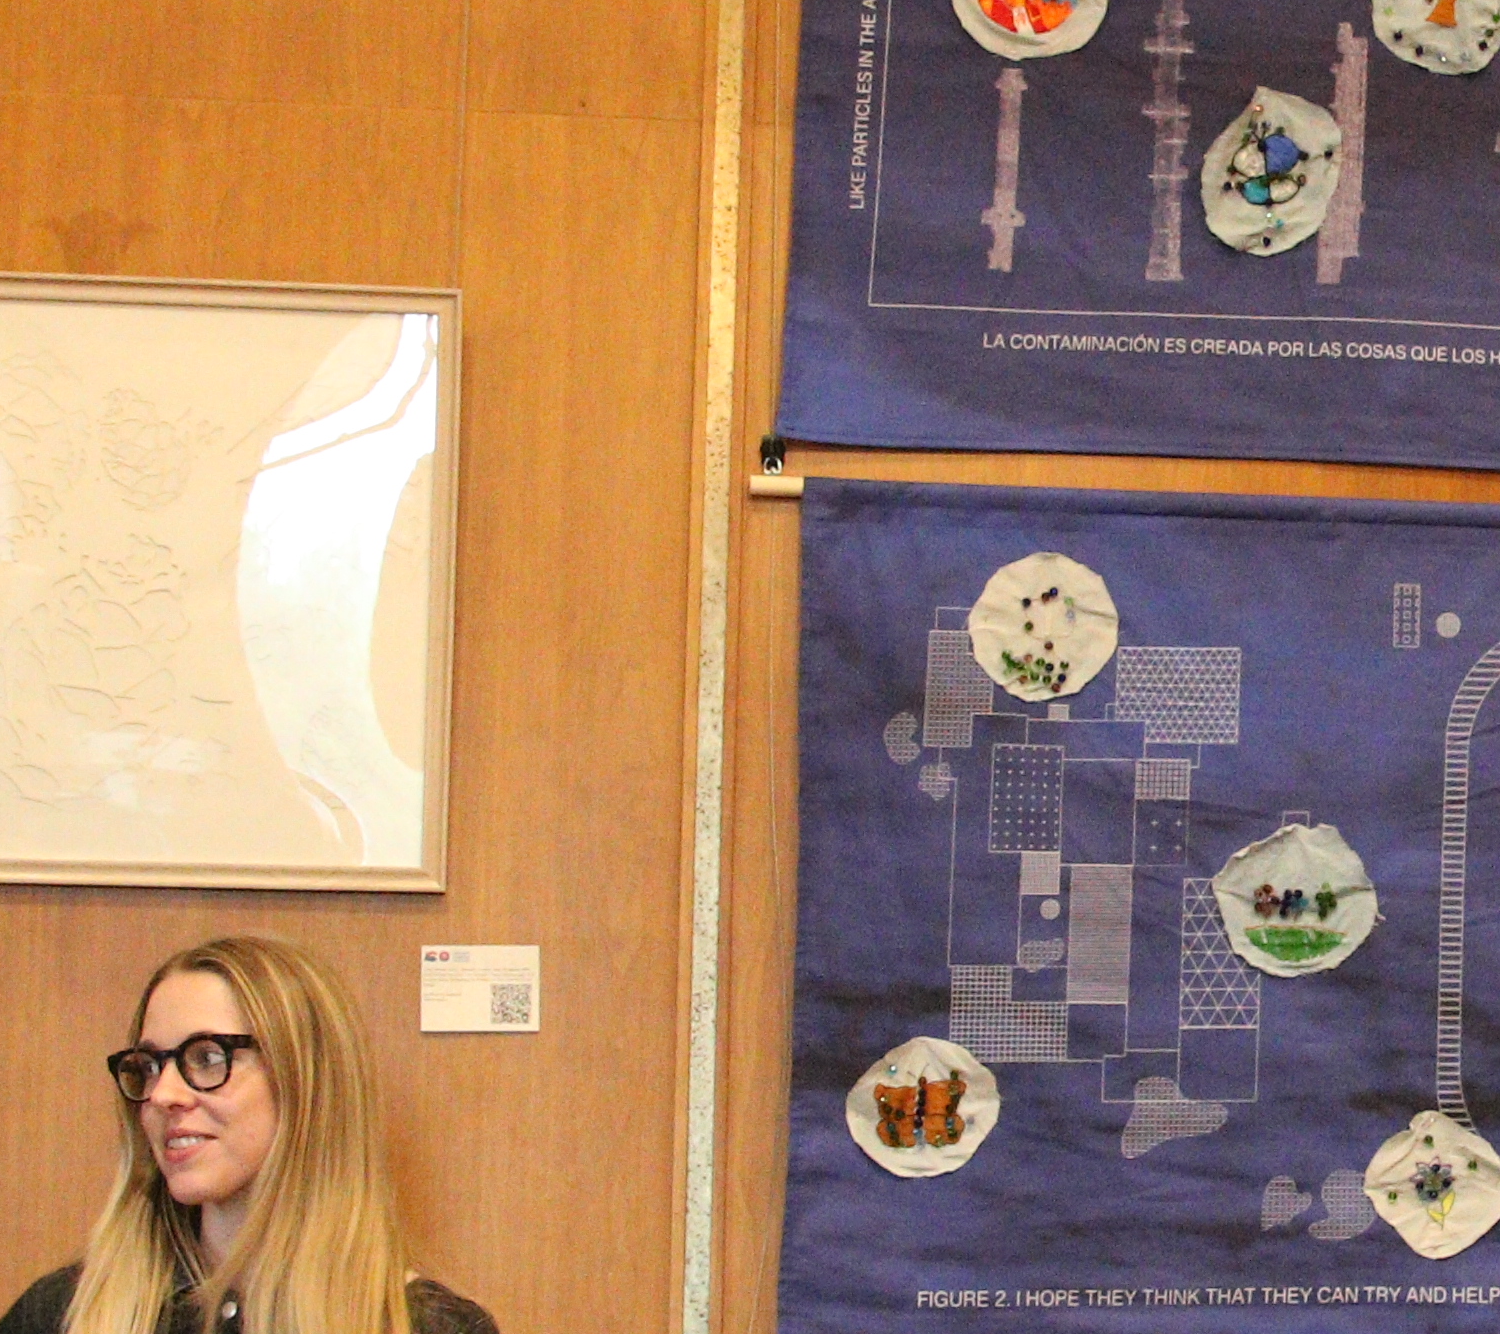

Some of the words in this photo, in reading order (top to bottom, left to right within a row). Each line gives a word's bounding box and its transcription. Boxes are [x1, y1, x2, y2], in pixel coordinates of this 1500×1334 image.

[859, 13, 877, 47] THE
[858, 49, 874, 69] IN
[852, 71, 873, 167] PARTICLES
[849, 171, 867, 210] LIKE
[982, 333, 1005, 349] LA
[1010, 333, 1160, 354] CONTAMINACIÓN
[1164, 337, 1186, 354] ES
[1190, 338, 1264, 356] CREADA
[1267, 341, 1304, 357] POR
[1308, 341, 1342, 357] LAS
[1346, 342, 1407, 361] COSAS
[1410, 345, 1448, 363] QUE
[1452, 348, 1486, 365] LOS
[916, 1290, 990, 1308] FIGURE
[994, 1290, 1011, 1307] 2.
[1016, 1290, 1021, 1307] I
[1025, 1289, 1080, 1307] HOPE
[1085, 1288, 1137, 1306] THEY
[1143, 1288, 1200, 1306] THINK
[1205, 1287, 1256, 1305] THAT
[1261, 1286, 1312, 1304] THEY
[1316, 1286, 1359, 1304] CAN
[1363, 1285, 1401, 1303] TRY
[1405, 1286, 1447, 1304] AND
[1451, 1286, 1500, 1305] HELP
